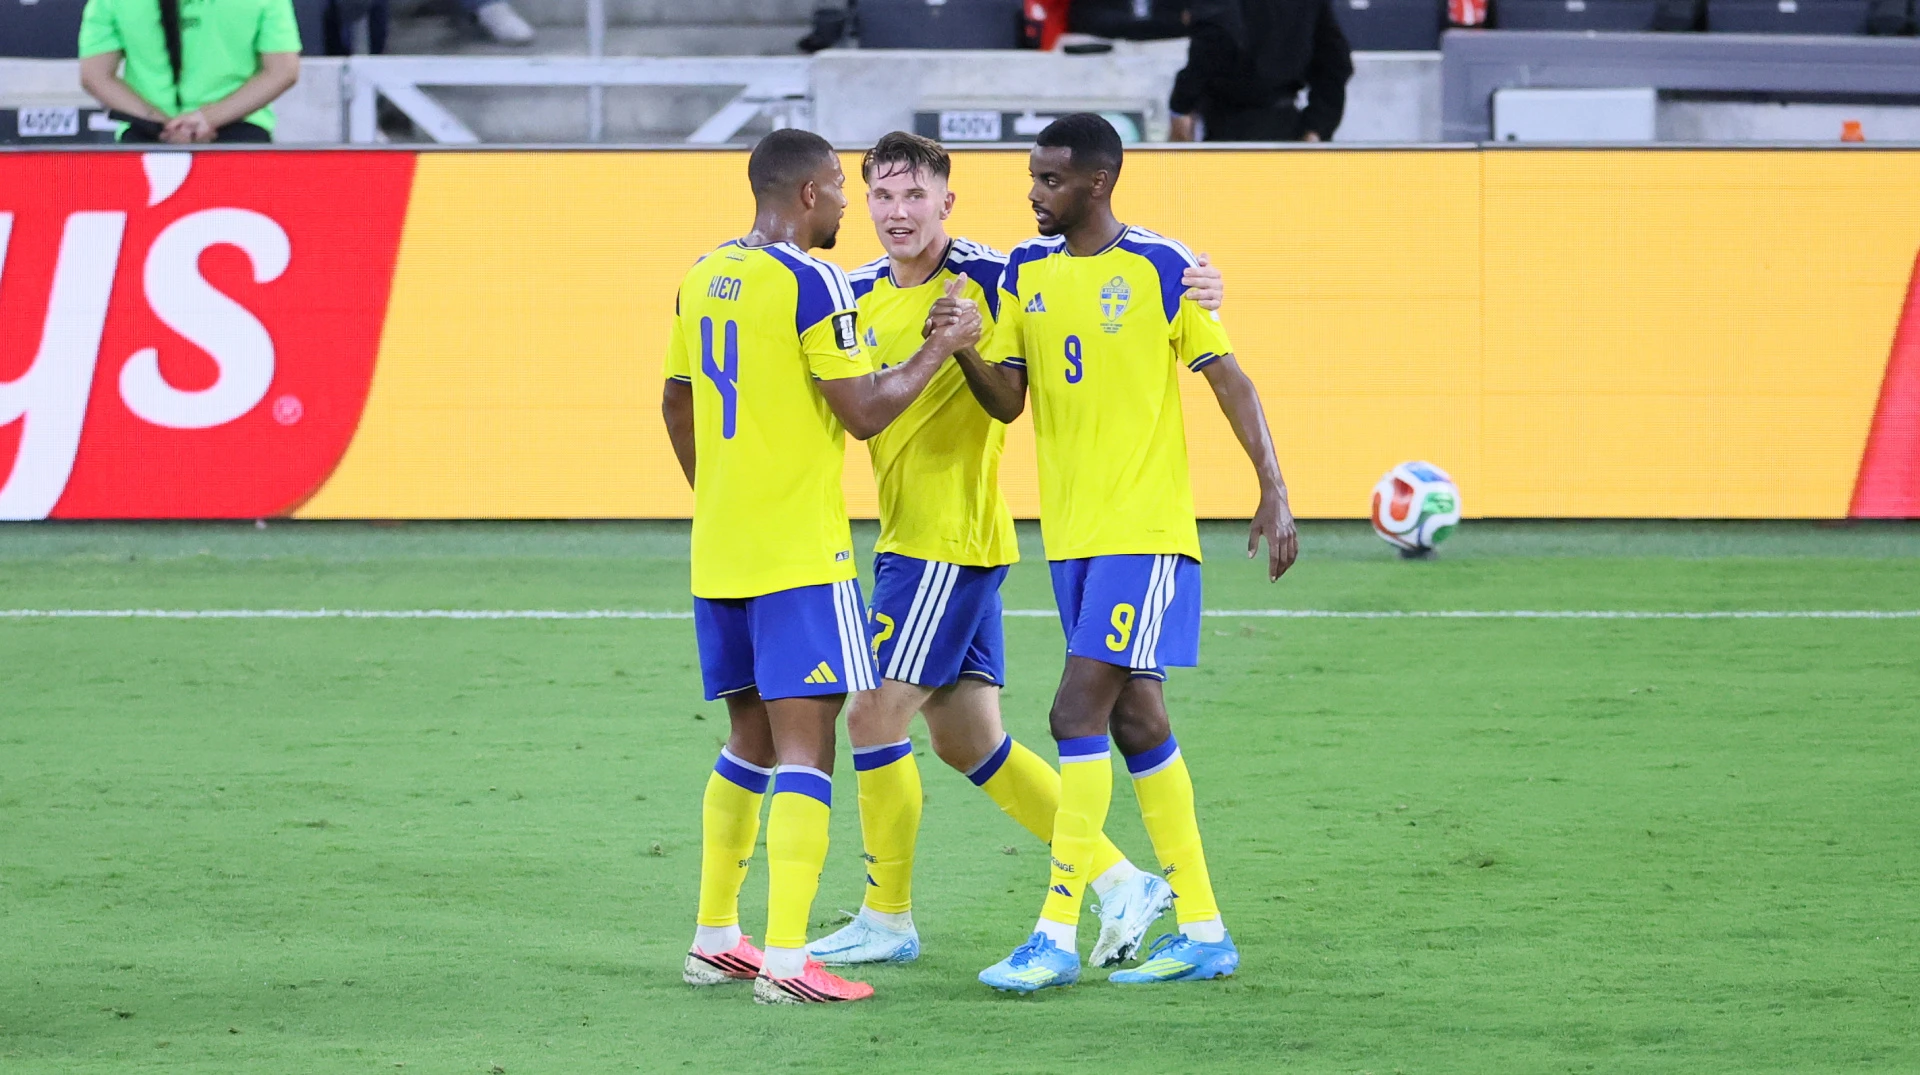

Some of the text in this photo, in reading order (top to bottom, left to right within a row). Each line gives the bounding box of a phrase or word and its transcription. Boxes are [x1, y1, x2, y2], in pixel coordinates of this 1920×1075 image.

[700, 316, 738, 439] 4
[1065, 334, 1083, 384] 9
[867, 607, 895, 660] 7
[1105, 602, 1136, 652] 9
